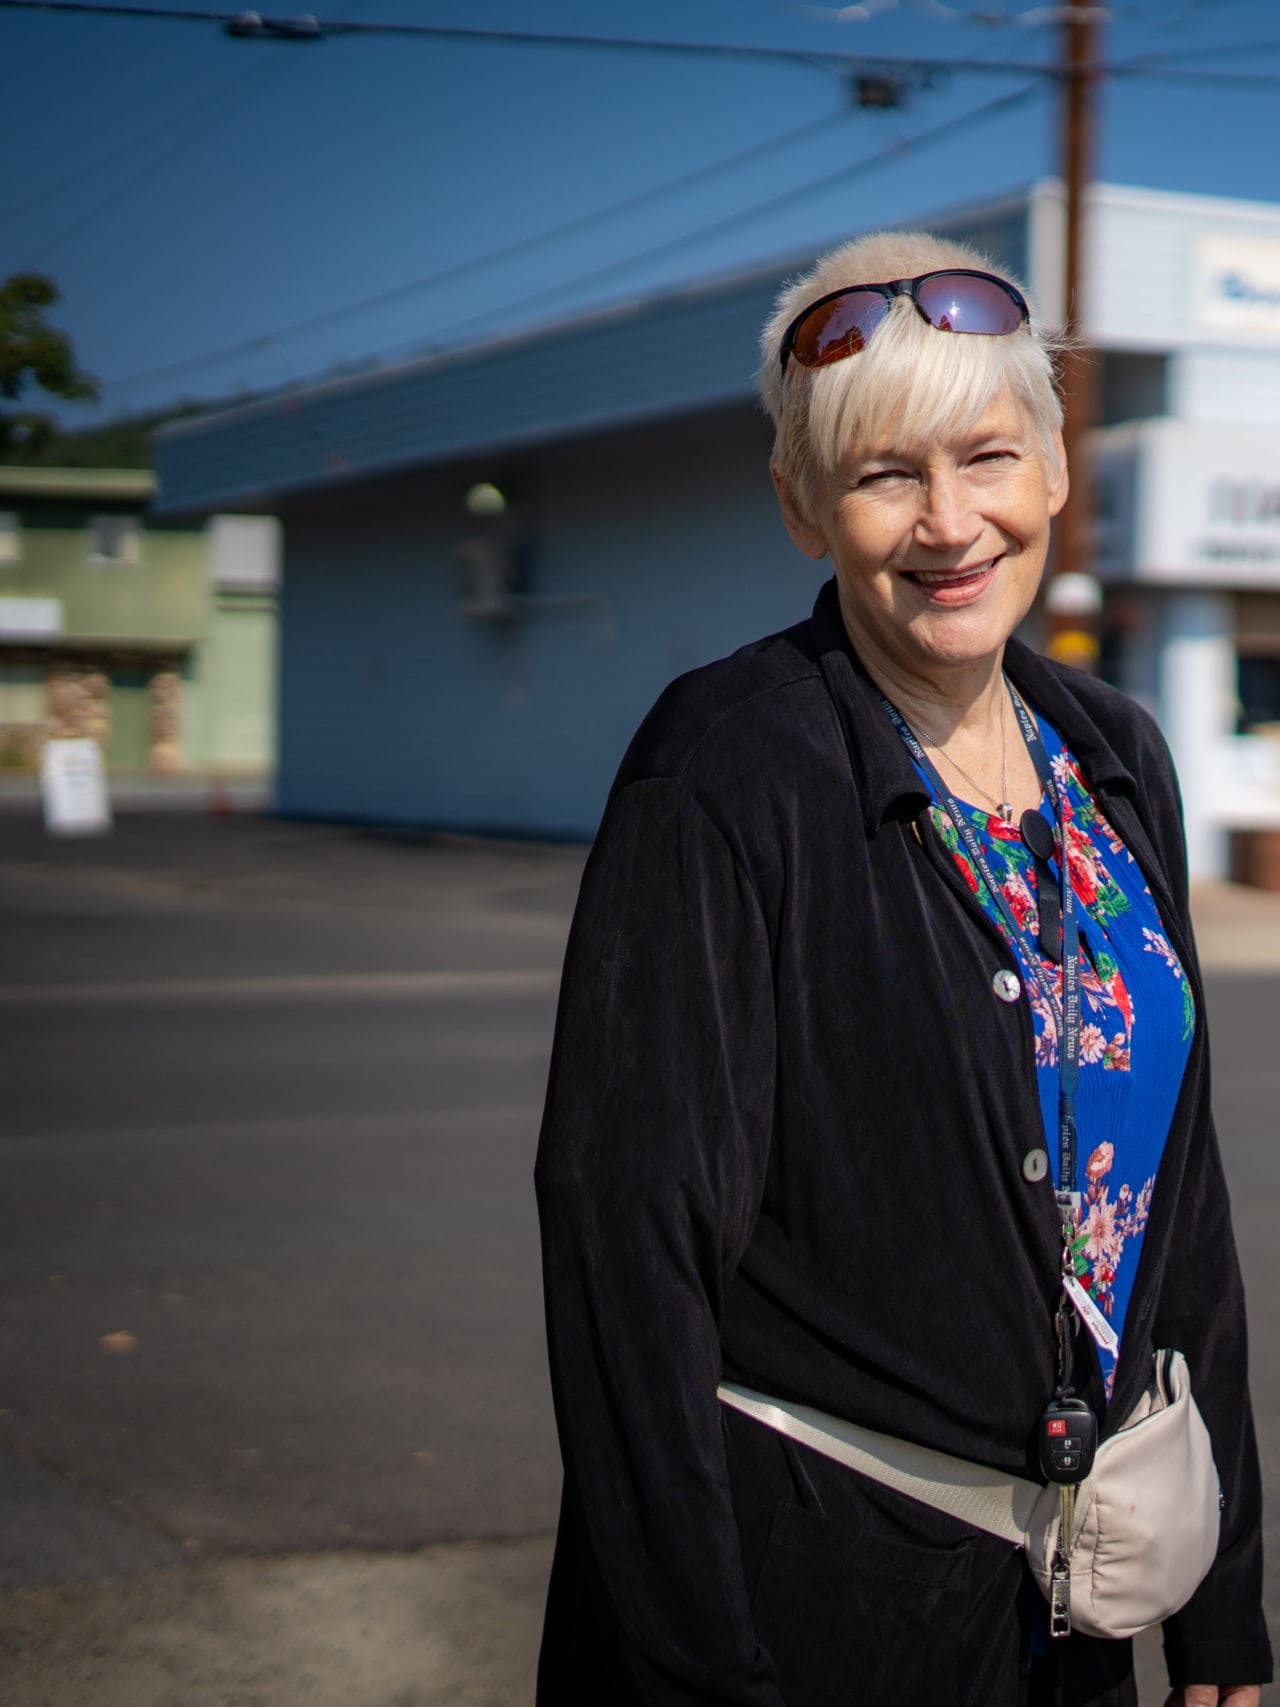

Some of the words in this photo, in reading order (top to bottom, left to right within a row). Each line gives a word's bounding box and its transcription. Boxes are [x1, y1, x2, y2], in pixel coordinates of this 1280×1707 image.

[1019, 709, 1037, 742] Naples
[947, 798, 966, 827] News
[963, 828, 981, 857] Daily
[979, 857, 1000, 894] Naples
[1066, 955, 1078, 992] Naples
[1066, 994, 1079, 1024] Daily
[1067, 1027, 1078, 1059] News
